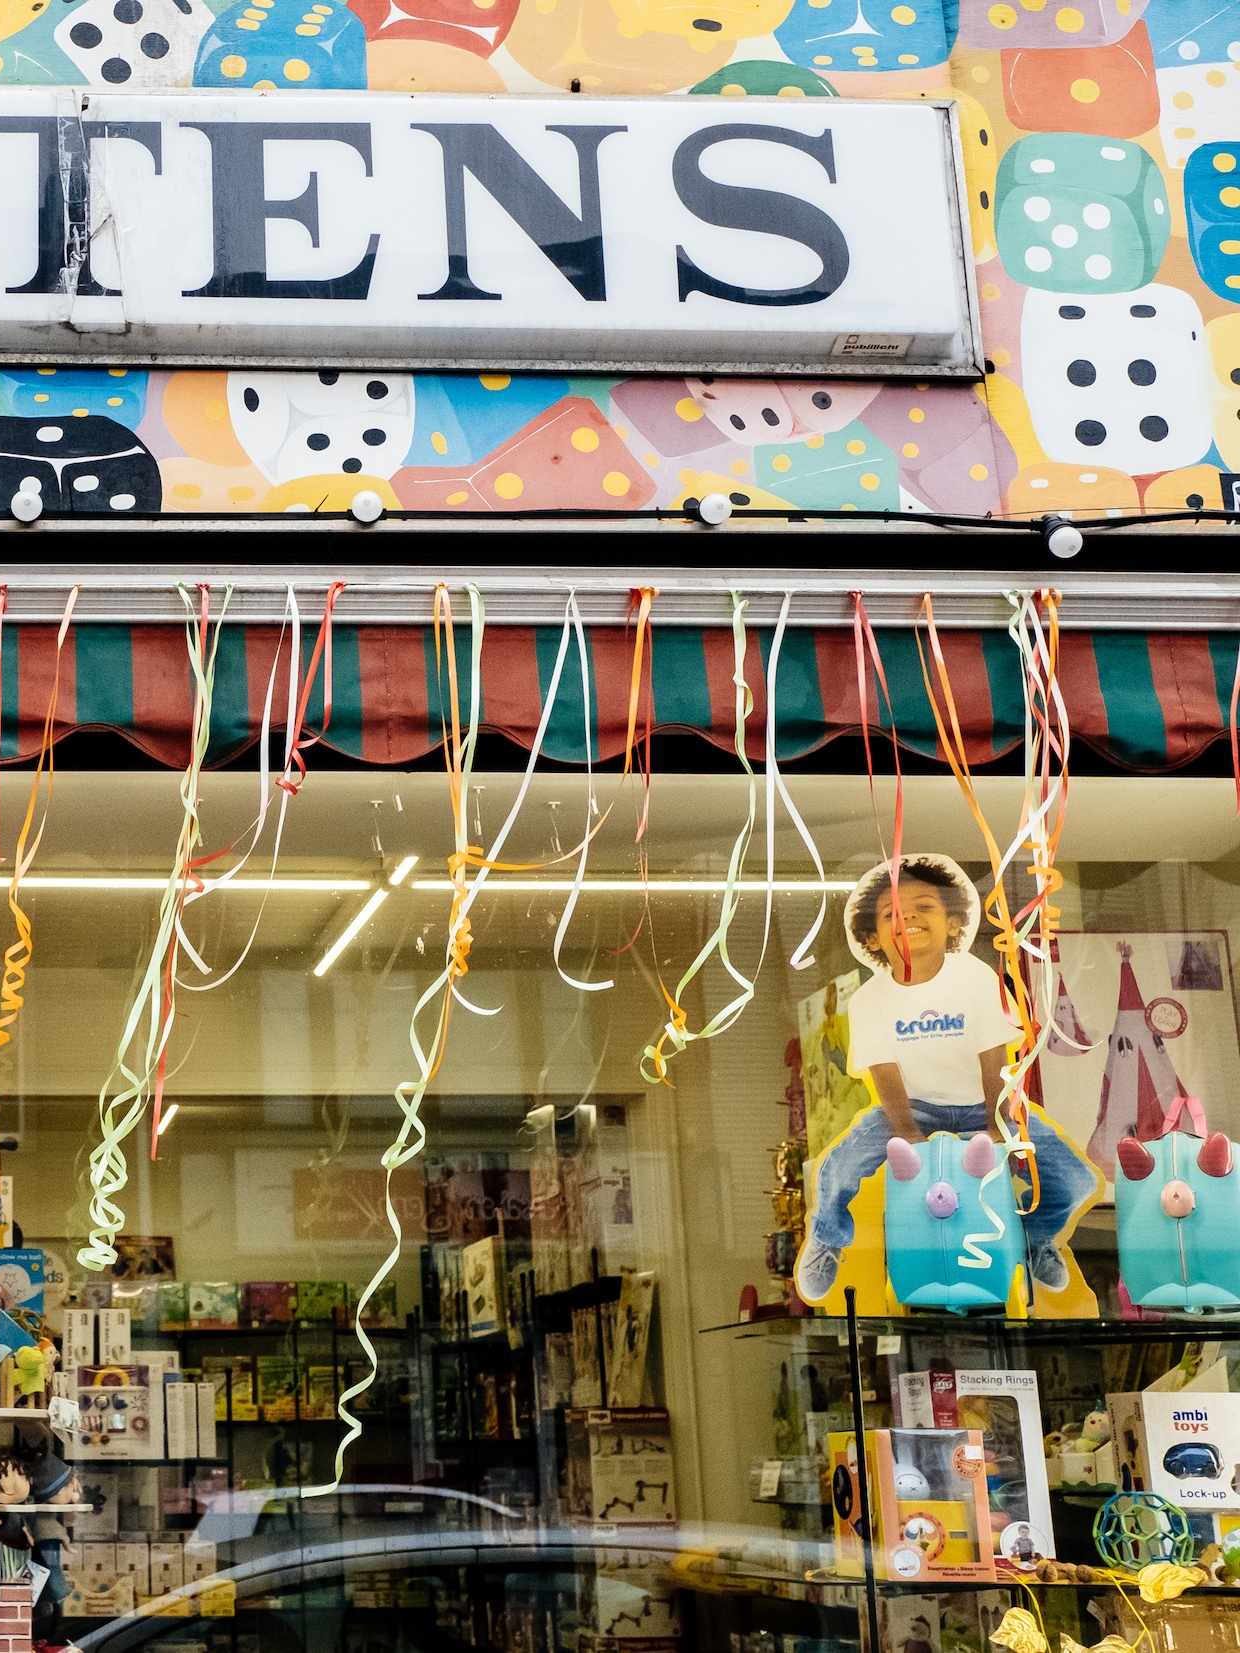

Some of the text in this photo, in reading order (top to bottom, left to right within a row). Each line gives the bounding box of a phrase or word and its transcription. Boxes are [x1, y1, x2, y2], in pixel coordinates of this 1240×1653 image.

[895, 1013, 965, 1035] trunki
[960, 1375, 1003, 1386] Stacking
[1005, 1375, 1034, 1386] Rings
[1173, 1410, 1208, 1421] ambi
[1173, 1422, 1209, 1434] toys
[1180, 1489, 1227, 1500] Lock-up
